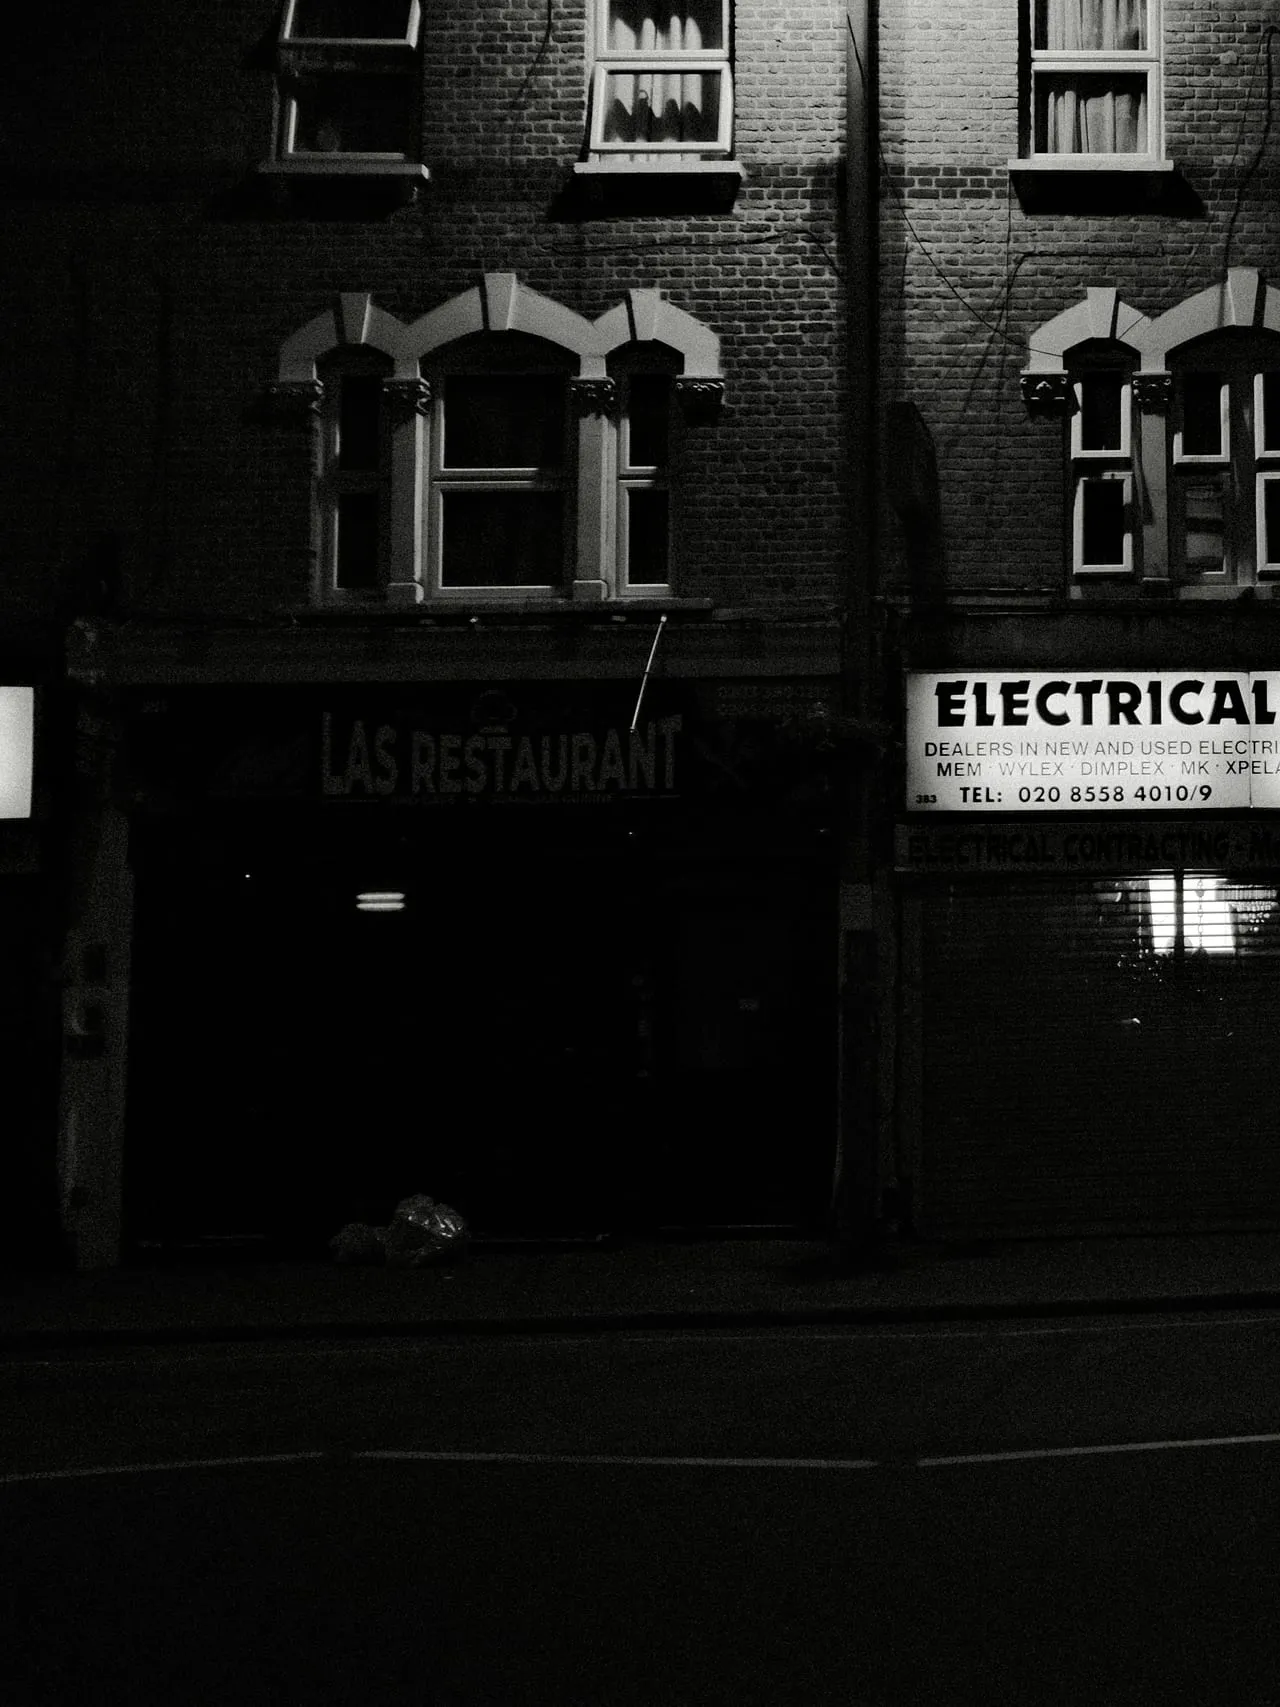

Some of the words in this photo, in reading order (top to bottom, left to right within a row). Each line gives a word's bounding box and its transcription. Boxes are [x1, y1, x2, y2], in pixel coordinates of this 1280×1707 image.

[935, 680, 1277, 727] ELECTRICAL
[321, 710, 399, 797] LAS
[410, 713, 683, 796] RESTAURANT
[924, 741, 1014, 757] DEALERS
[1020, 741, 1039, 756] IN
[1045, 741, 1089, 756] NEW
[1095, 741, 1135, 755] AND
[1141, 740, 1193, 755] USED
[936, 762, 982, 777] MEM
[999, 762, 1064, 776] WYLEX
[1081, 761, 1164, 776] DIMPLEX
[1181, 761, 1210, 775] MK
[915, 794, 937, 804] 383
[960, 787, 1002, 803] TEL:
[1018, 786, 1060, 802] 020
[1070, 786, 1124, 802] 8558
[1134, 784, 1213, 802] 4010/9
[908, 834, 1056, 863] ELECTRICAL
[1064, 832, 1231, 862] CONTRACTING
